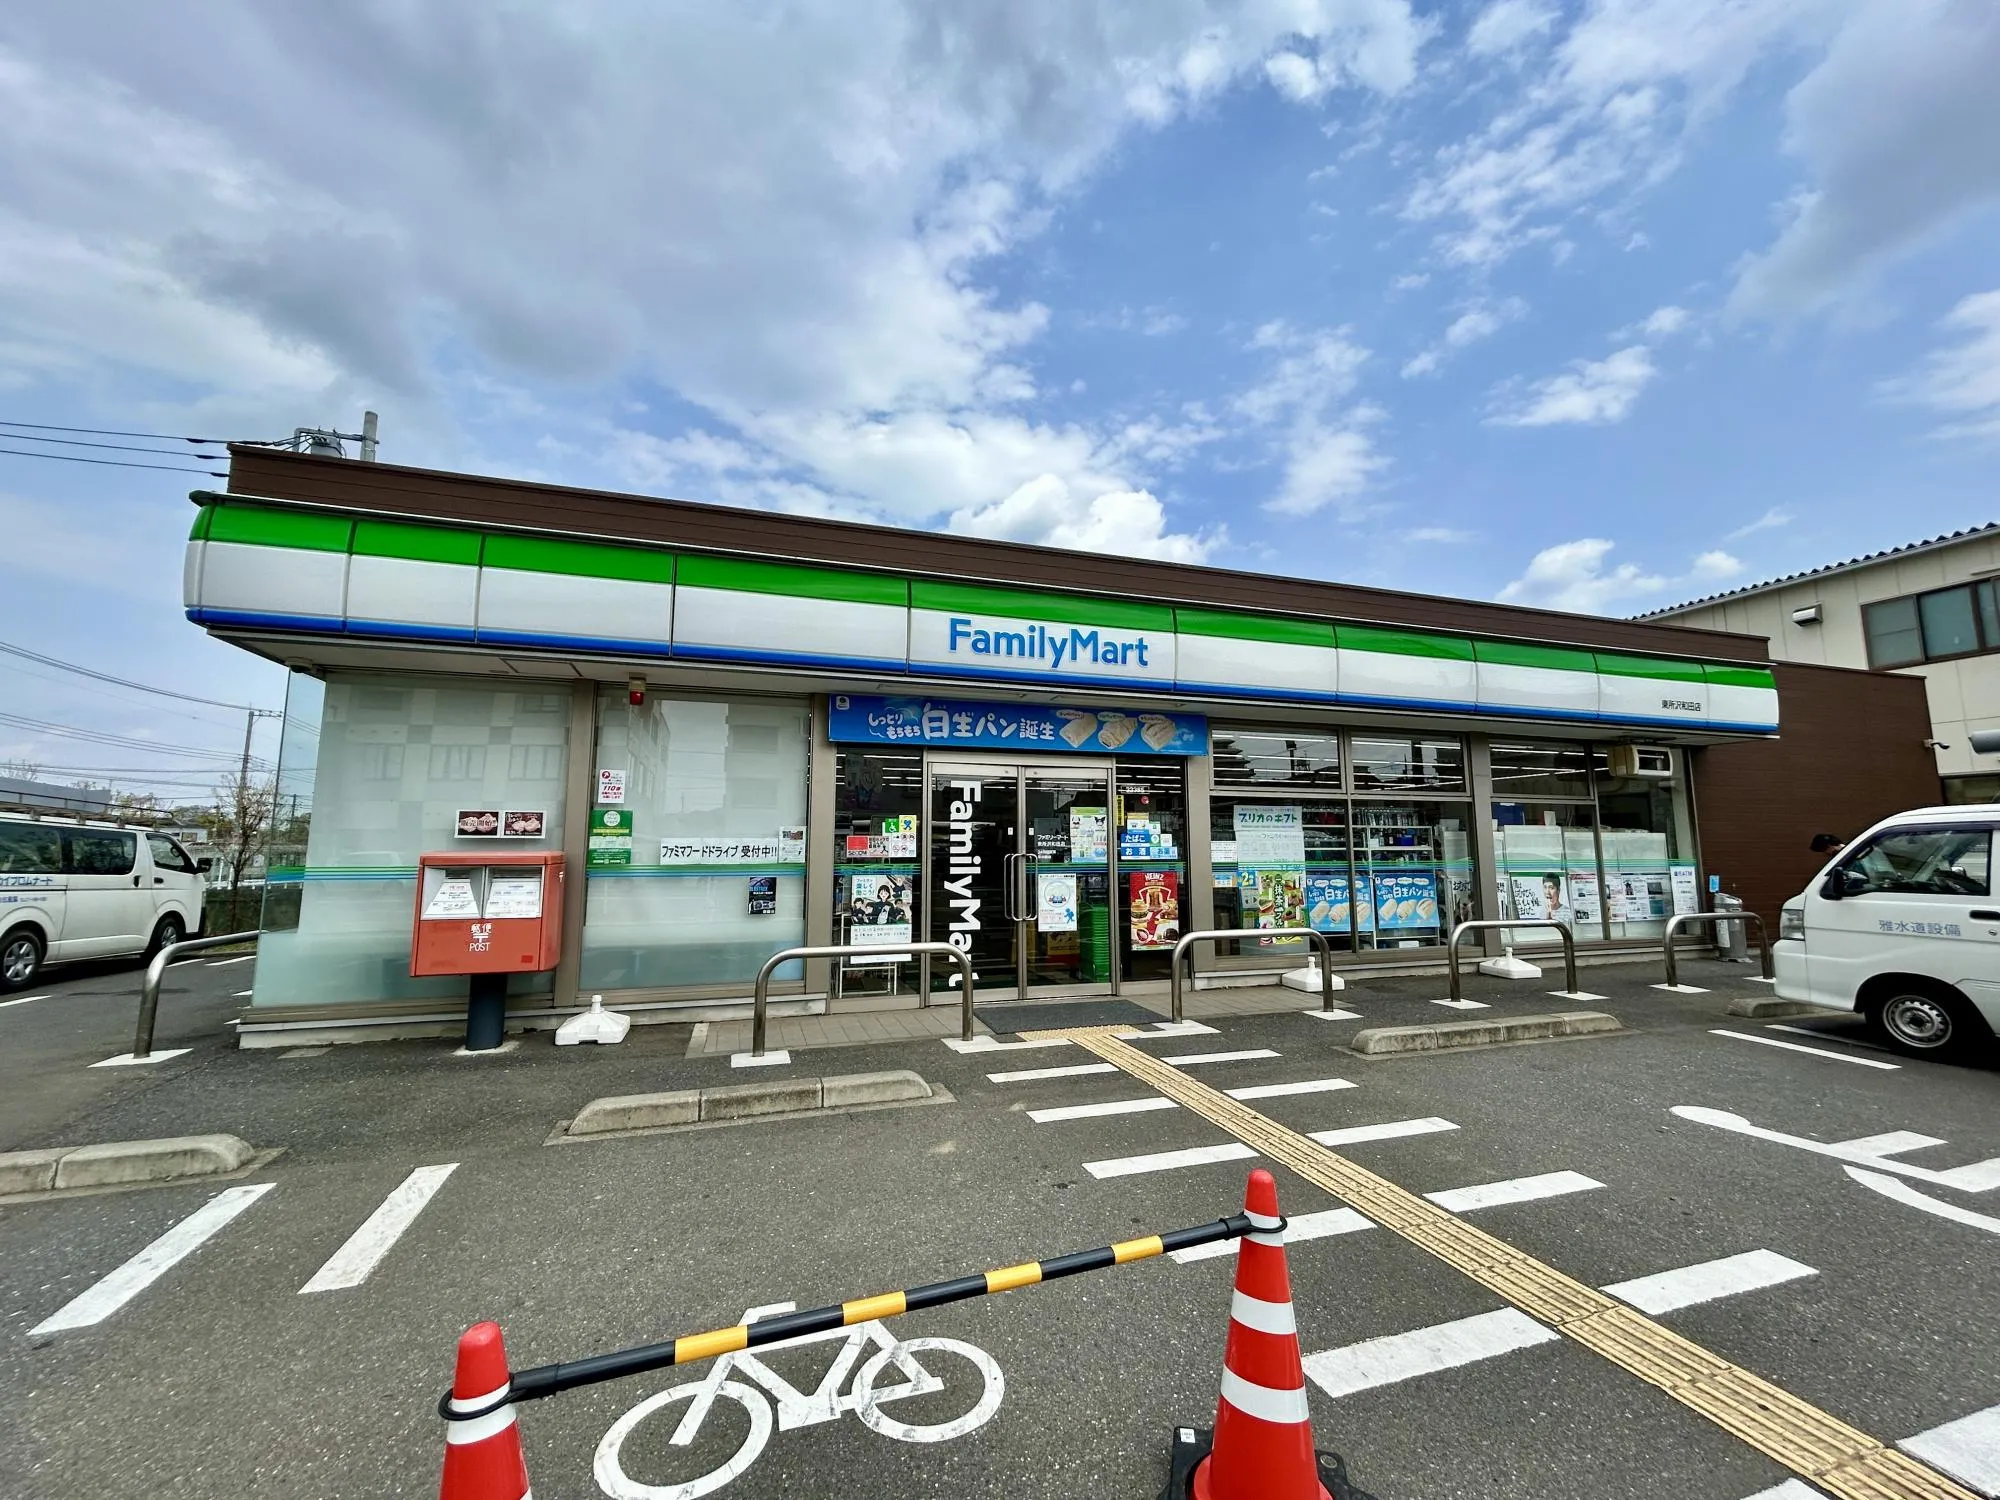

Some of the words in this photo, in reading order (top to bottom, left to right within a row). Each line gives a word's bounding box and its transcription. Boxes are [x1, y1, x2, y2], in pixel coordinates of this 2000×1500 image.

[950, 617, 1149, 669] FamilyMart
[1661, 699, 1701, 711] 東所沢和田店
[868, 712, 904, 727] しっとり
[886, 725, 921, 740] もちもち
[1125, 834, 1146, 843] たばこ
[1144, 872, 1165, 881] HEINZ
[1878, 919, 1961, 937] 雅水道設備
[469, 942, 491, 952] POST
